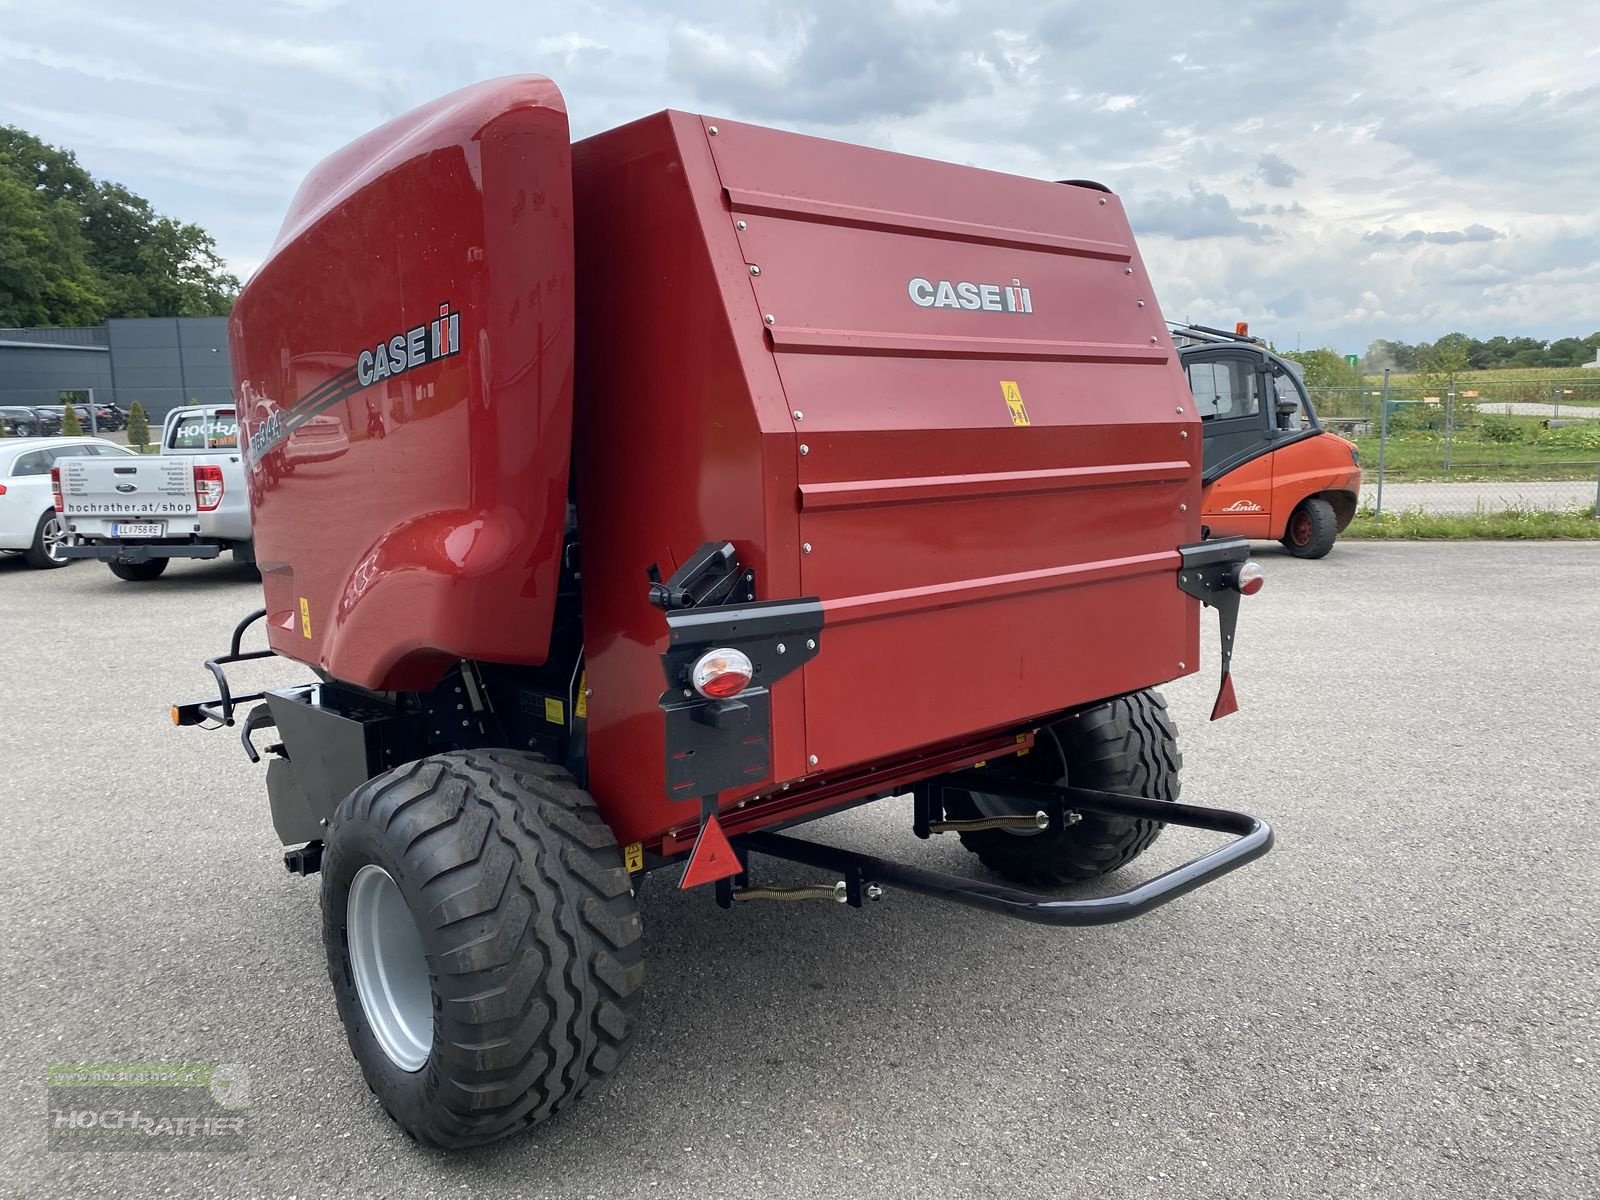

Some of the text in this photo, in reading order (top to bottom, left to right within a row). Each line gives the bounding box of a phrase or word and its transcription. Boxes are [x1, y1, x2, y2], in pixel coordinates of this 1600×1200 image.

[908, 277, 1002, 311] CASE
[357, 326, 426, 386] CASE
[68, 502, 192, 513] hochrather.at/shop
[1222, 499, 1262, 512] Linde
